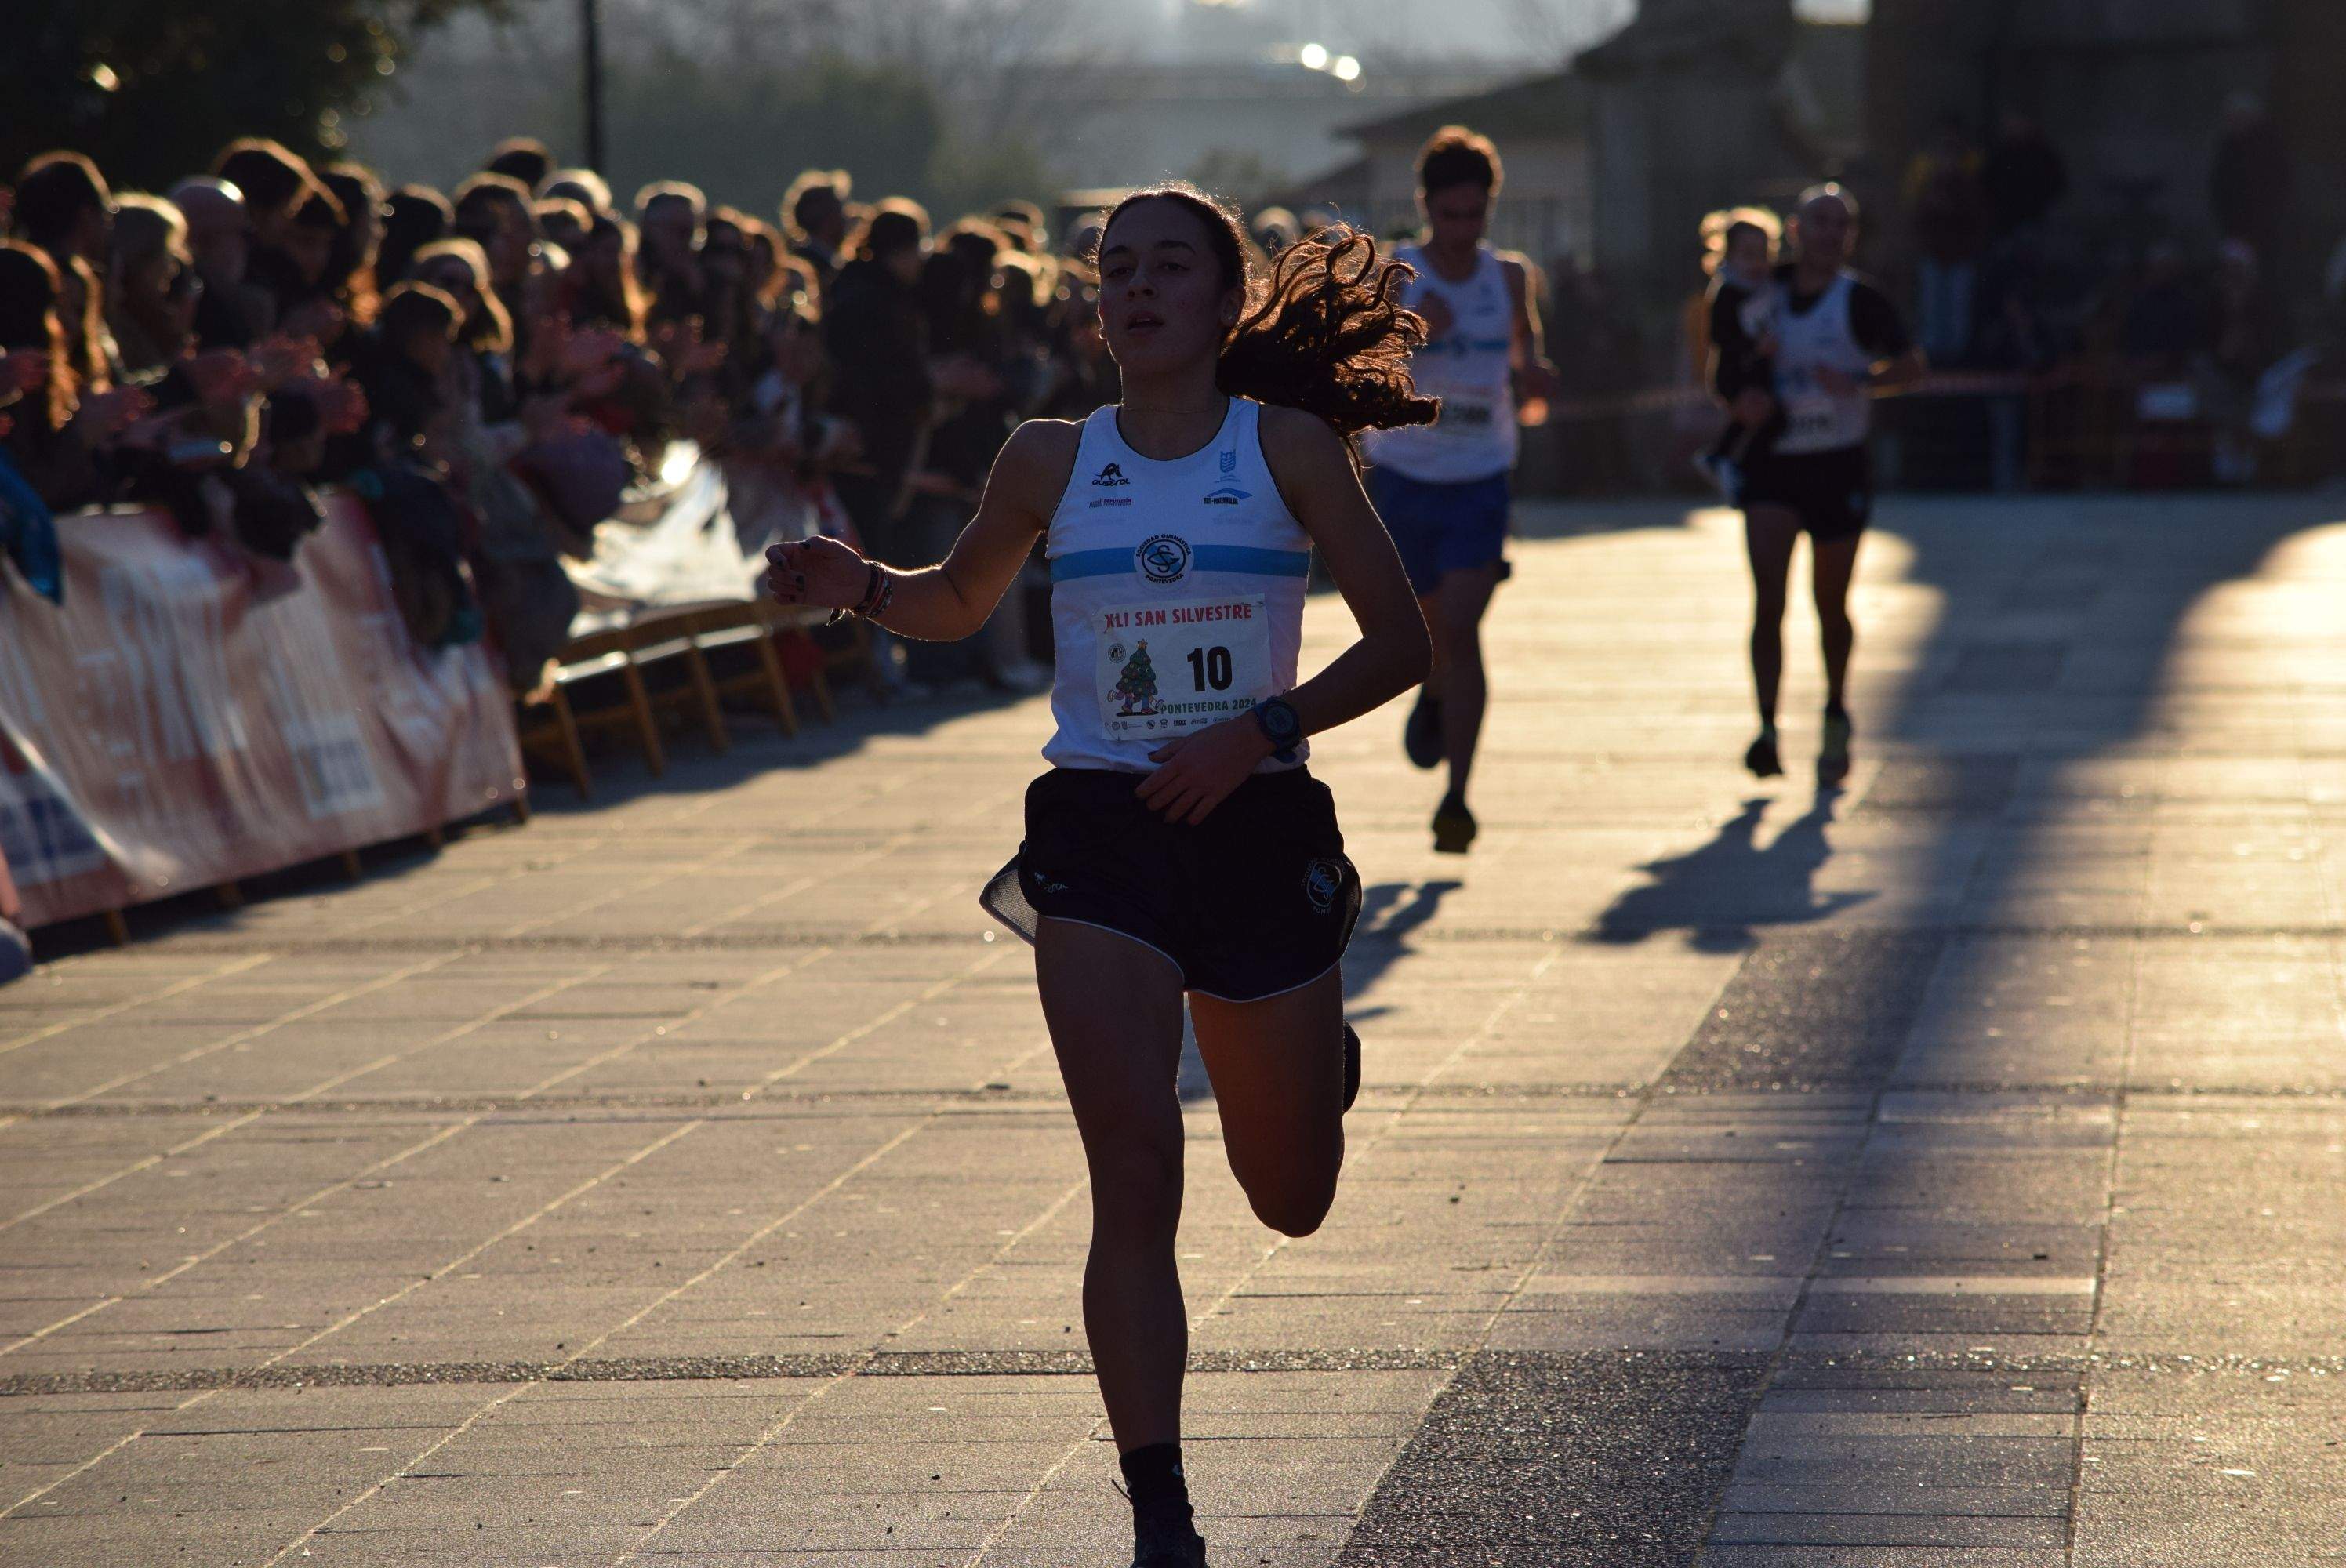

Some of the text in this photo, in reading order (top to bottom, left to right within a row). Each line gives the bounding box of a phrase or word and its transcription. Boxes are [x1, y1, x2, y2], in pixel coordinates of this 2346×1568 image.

[1135, 535, 1160, 557] SOCIEDAD
[1145, 573, 1185, 585] PONTEVEDRA
[1104, 604, 1252, 629] XLI SAN SILVESTRE
[1187, 646, 1233, 691] 10
[1161, 697, 1257, 715] PONTEVEDRA 2024
